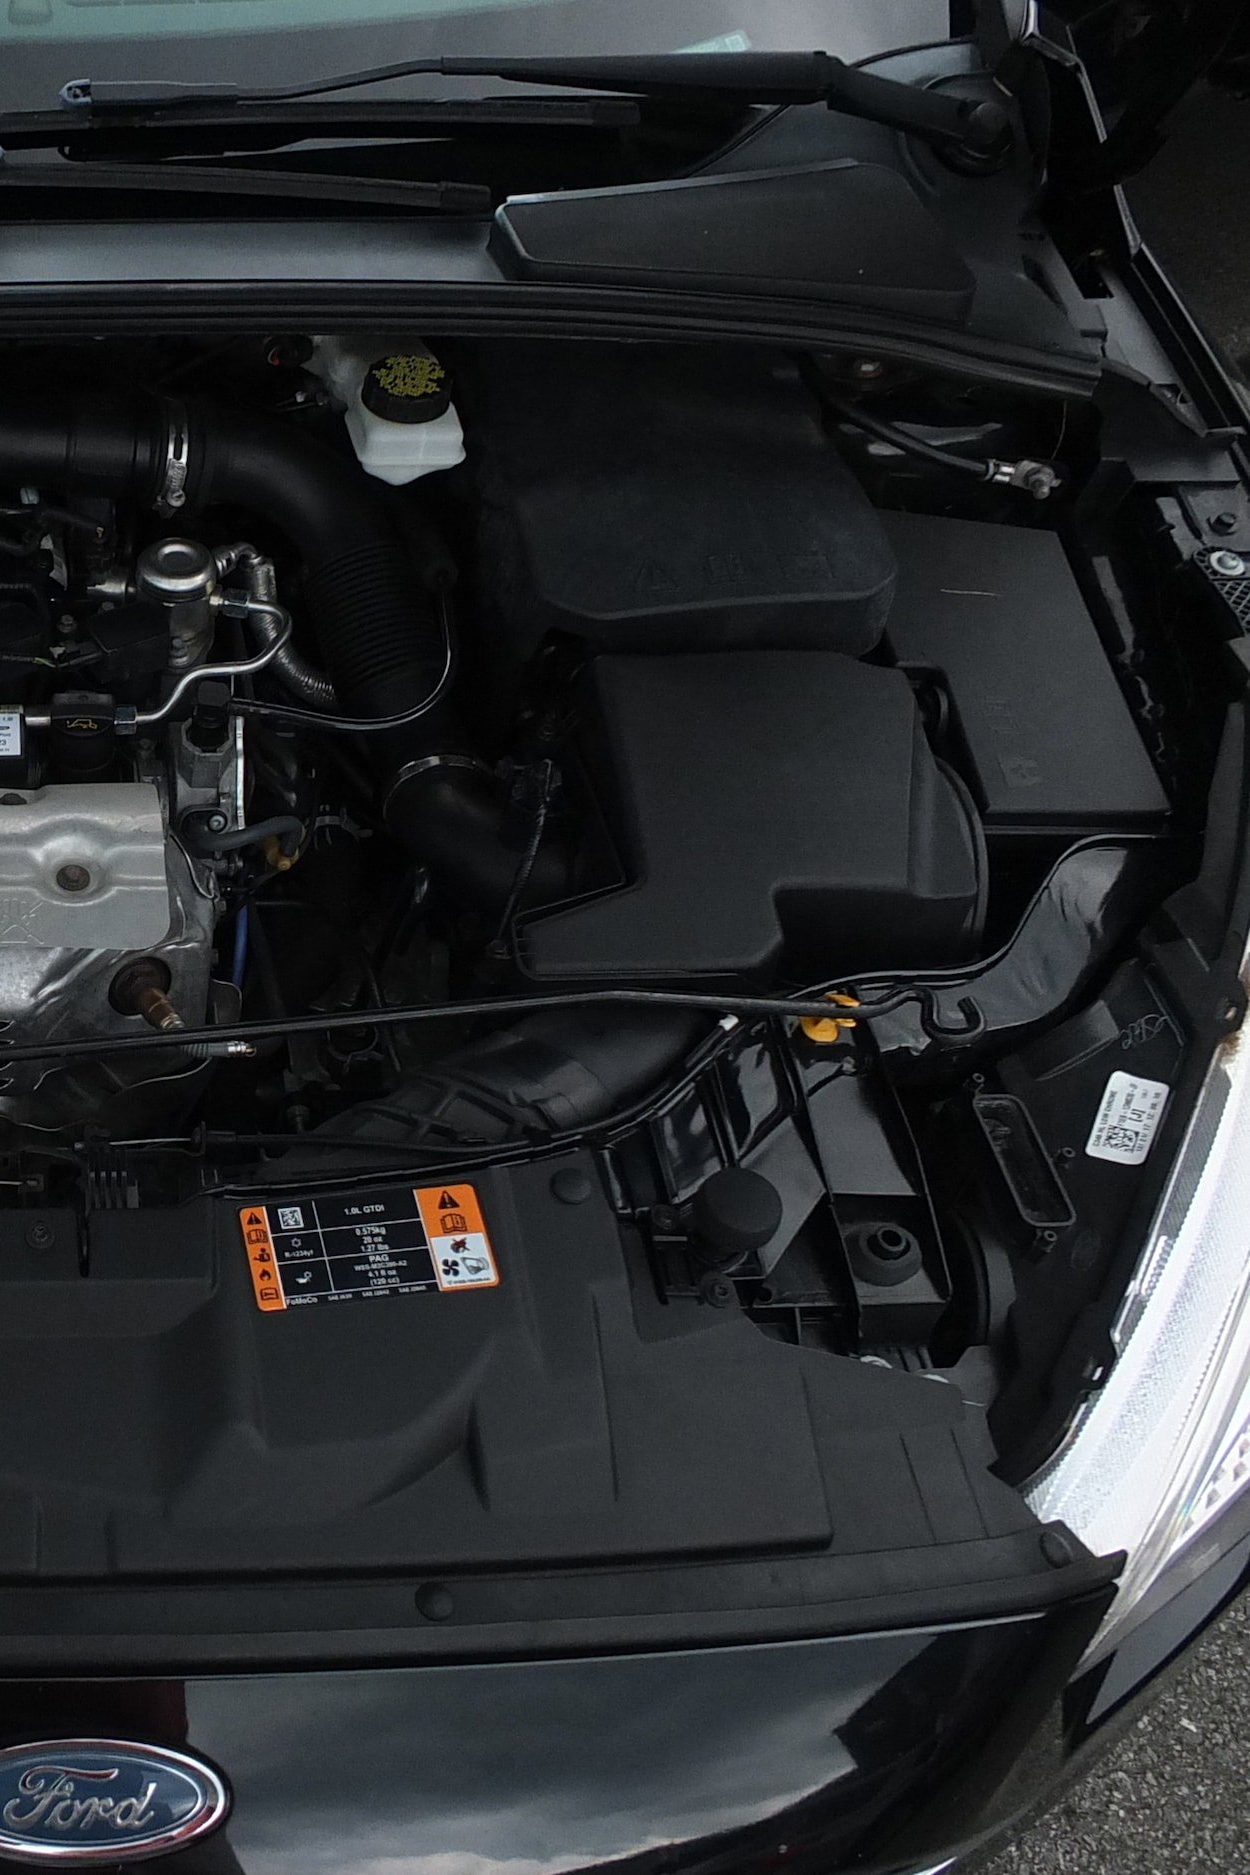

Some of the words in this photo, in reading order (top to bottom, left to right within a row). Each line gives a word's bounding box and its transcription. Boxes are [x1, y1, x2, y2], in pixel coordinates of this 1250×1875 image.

[344, 1206, 362, 1216] 1.0L
[364, 1204, 385, 1214] GTDI
[368, 1254, 390, 1263] PAG
[286, 1296, 318, 1305] FoMoCo
[3, 1765, 158, 1830] Ford
